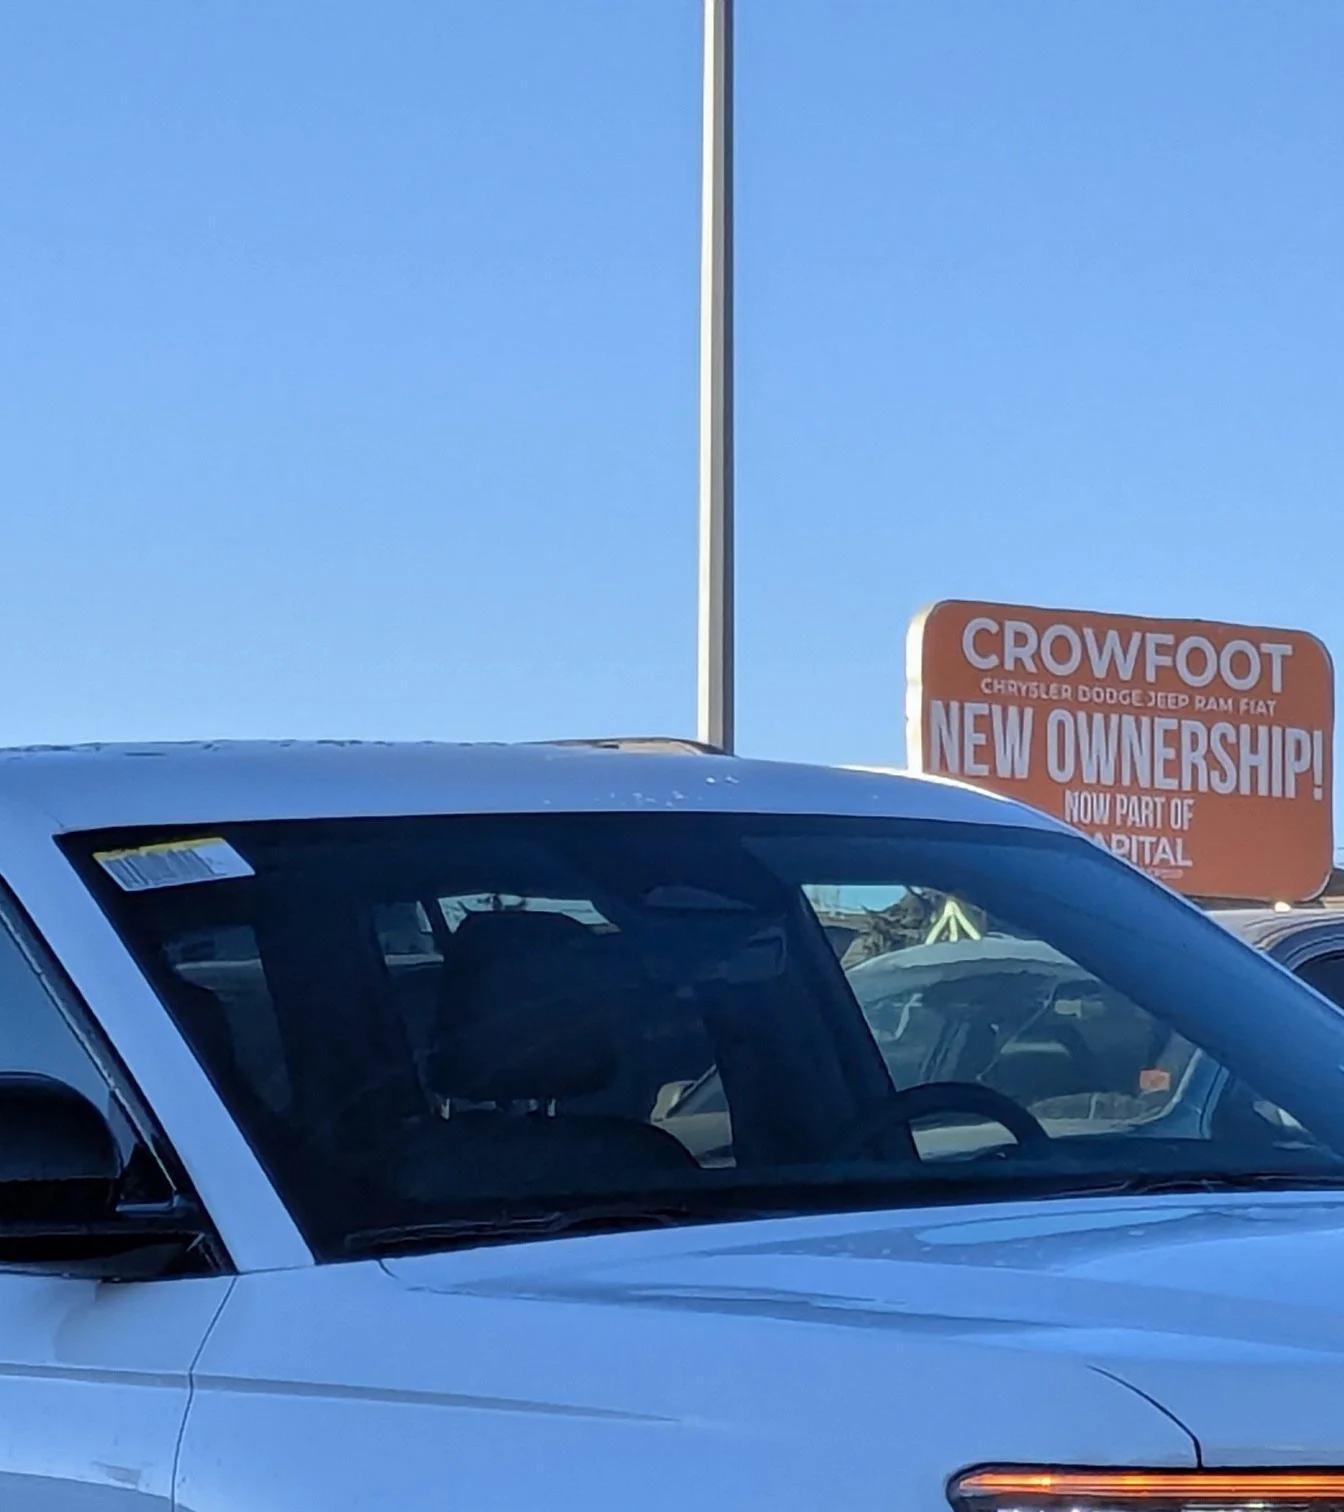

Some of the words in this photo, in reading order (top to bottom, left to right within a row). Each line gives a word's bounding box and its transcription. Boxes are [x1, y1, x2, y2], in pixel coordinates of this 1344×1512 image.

[961, 616, 1293, 694] CROWFOOT
[980, 677, 1072, 701] CHRYSLER
[1078, 685, 1142, 708] DODGE
[1142, 690, 1190, 711] JEEP
[1195, 695, 1233, 713] RAM
[1239, 698, 1278, 718] FIAT
[930, 699, 1034, 779] NEW
[1046, 708, 1324, 801] OWNERSHIP!
[1064, 789, 1111, 826] NOW
[1115, 793, 1166, 829] PART
[1169, 798, 1195, 831] OF
